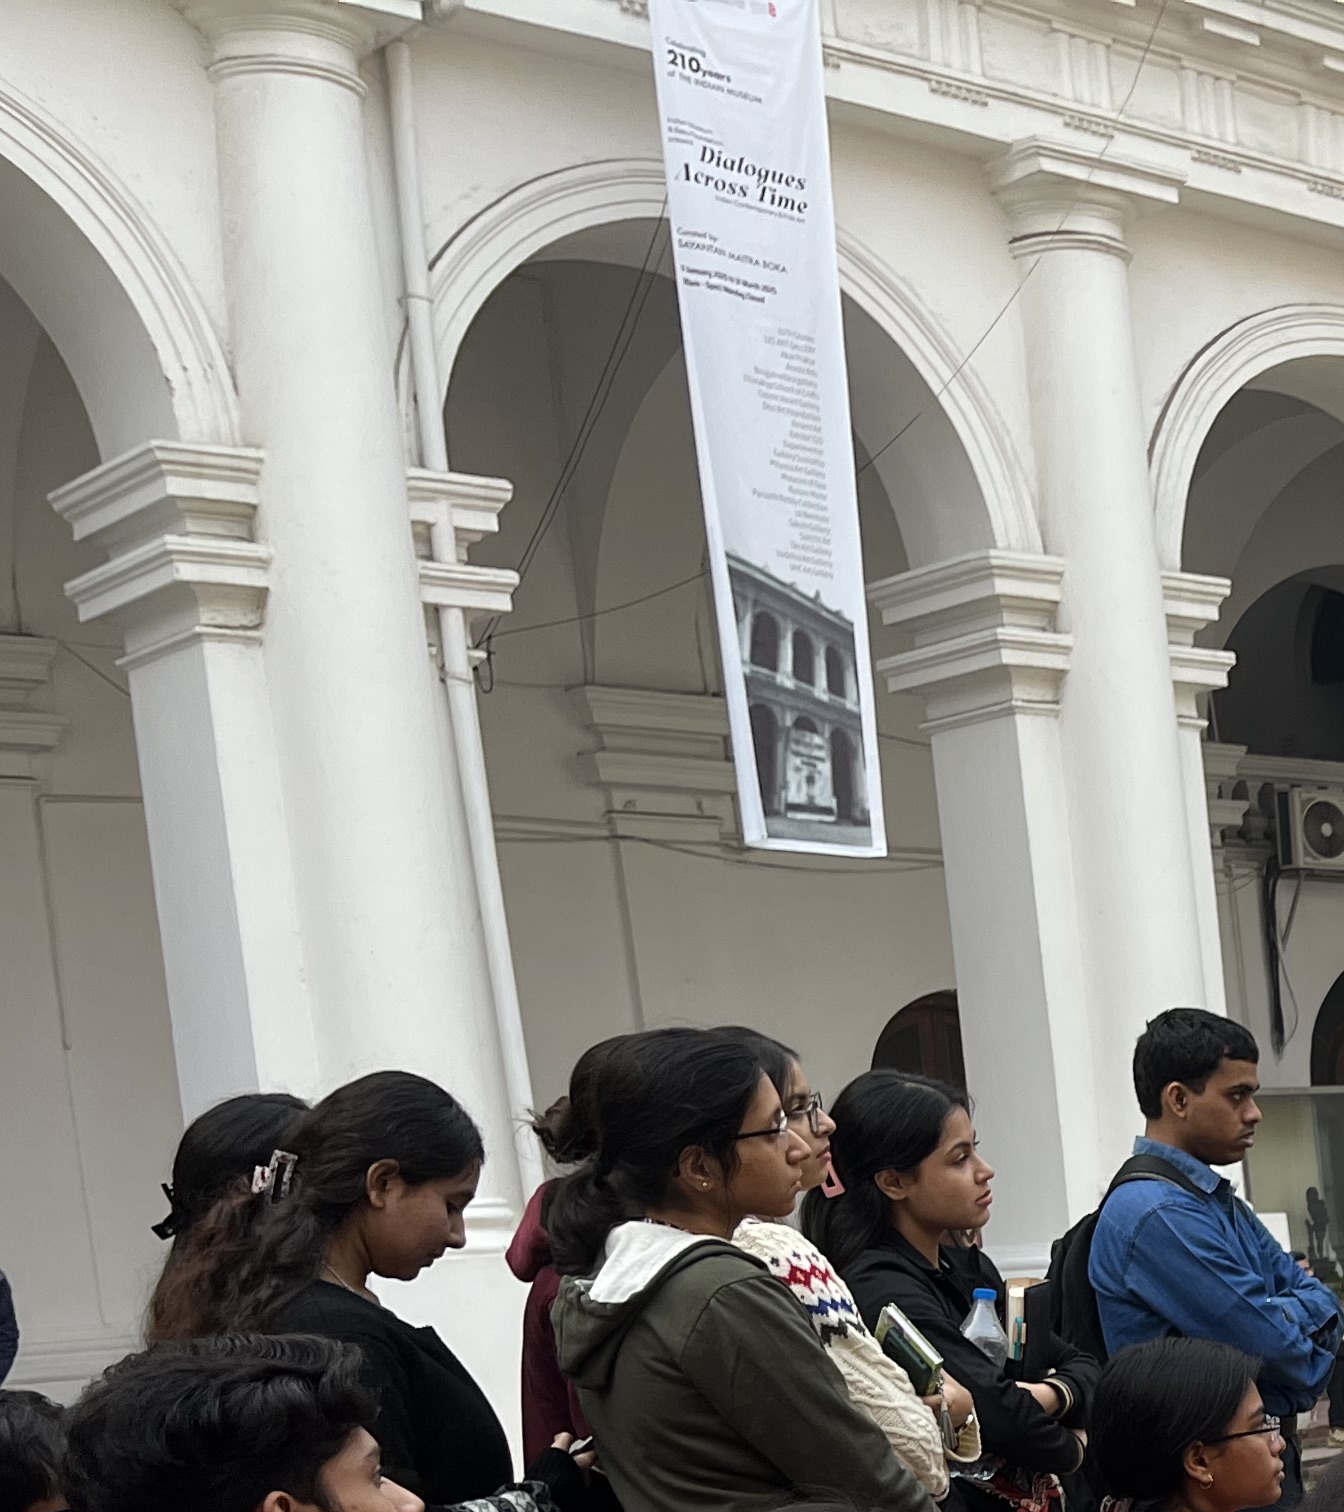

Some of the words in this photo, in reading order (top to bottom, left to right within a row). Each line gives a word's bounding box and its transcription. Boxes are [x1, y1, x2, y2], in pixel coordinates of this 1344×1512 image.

[667, 49, 700, 73] 210
[674, 162, 749, 198] Across
[756, 183, 808, 214] Time
[700, 145, 807, 191] Dialogues
